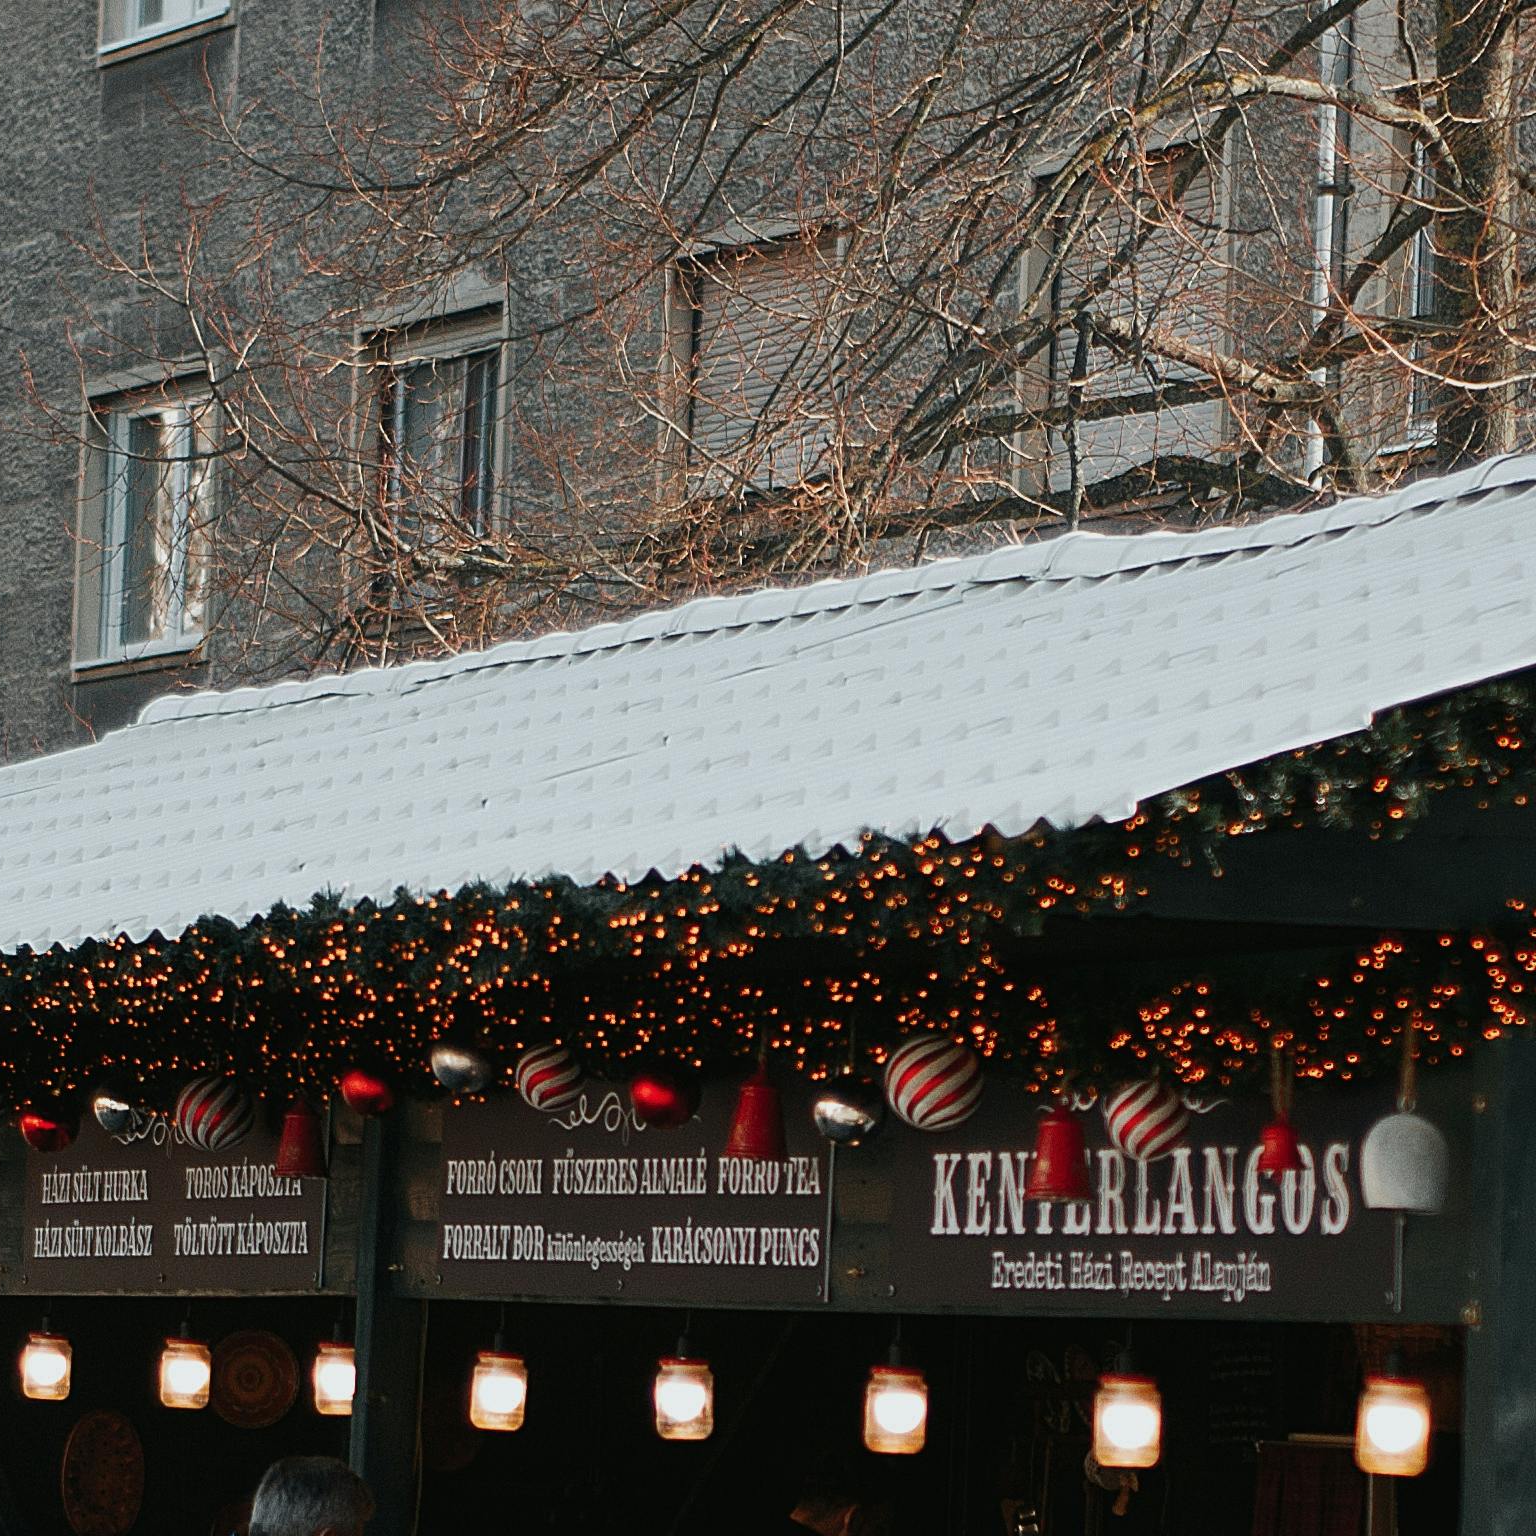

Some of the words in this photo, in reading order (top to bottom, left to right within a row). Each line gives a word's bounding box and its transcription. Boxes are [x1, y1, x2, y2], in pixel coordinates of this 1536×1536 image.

[42, 1164, 71, 1204] HÁZI
[72, 1165, 102, 1203] SÜLT
[103, 1169, 148, 1201] HURKA
[185, 1166, 228, 1199] TOROS
[230, 1156, 302, 1198] KÁPOSZTA
[446, 1151, 495, 1194] FORRÓ
[499, 1159, 542, 1194] CSOKI
[552, 1148, 637, 1195] FŰSZERES
[639, 1147, 706, 1195] ALMALÉ
[783, 1157, 821, 1194] TEA
[33, 1219, 62, 1258] HÁZI
[64, 1220, 94, 1257] SÜLT
[95, 1216, 153, 1257] KOLBÁSZ
[174, 1216, 236, 1256] TÖLTÖTT
[236, 1213, 308, 1255] KÁPOSZTA
[443, 1225, 510, 1260] FORRALT
[512, 1225, 545, 1260] BOR
[546, 1230, 645, 1271] különlegességek
[651, 1216, 756, 1265] KARÁCSONYI
[758, 1228, 820, 1267] PUNCS
[991, 1251, 1065, 1288] Eredeti
[1067, 1251, 1116, 1290] Házi
[1118, 1251, 1186, 1301] Recept
[1190, 1251, 1271, 1302] Alapján
